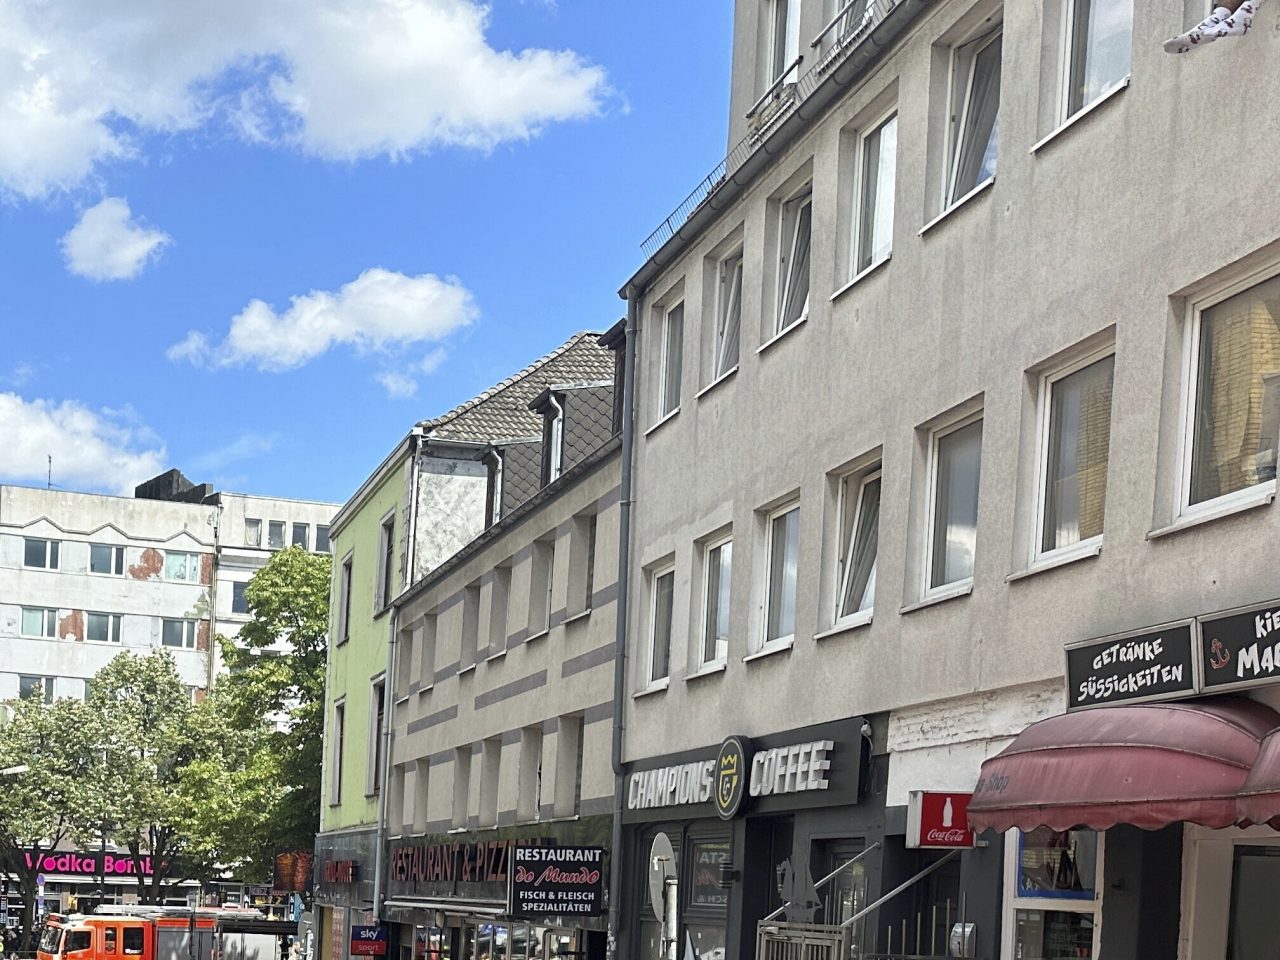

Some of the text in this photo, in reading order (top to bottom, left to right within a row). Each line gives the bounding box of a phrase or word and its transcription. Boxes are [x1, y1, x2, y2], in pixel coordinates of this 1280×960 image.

[1092, 637, 1163, 669] GETRÄNKE
[628, 740, 834, 810] CHAMPIONS COFFEE
[23, 852, 96, 873] Vodka
[392, 843, 459, 881] RESTAURANT
[462, 845, 471, 881] &
[516, 848, 602, 862] RESTAURANT
[515, 865, 600, 887] do Mundo
[519, 890, 595, 901] FISCH & FLEISCH
[522, 901, 592, 912] SPEZIALITÄTEN
[360, 928, 379, 940] sky
[358, 943, 379, 952] sport
